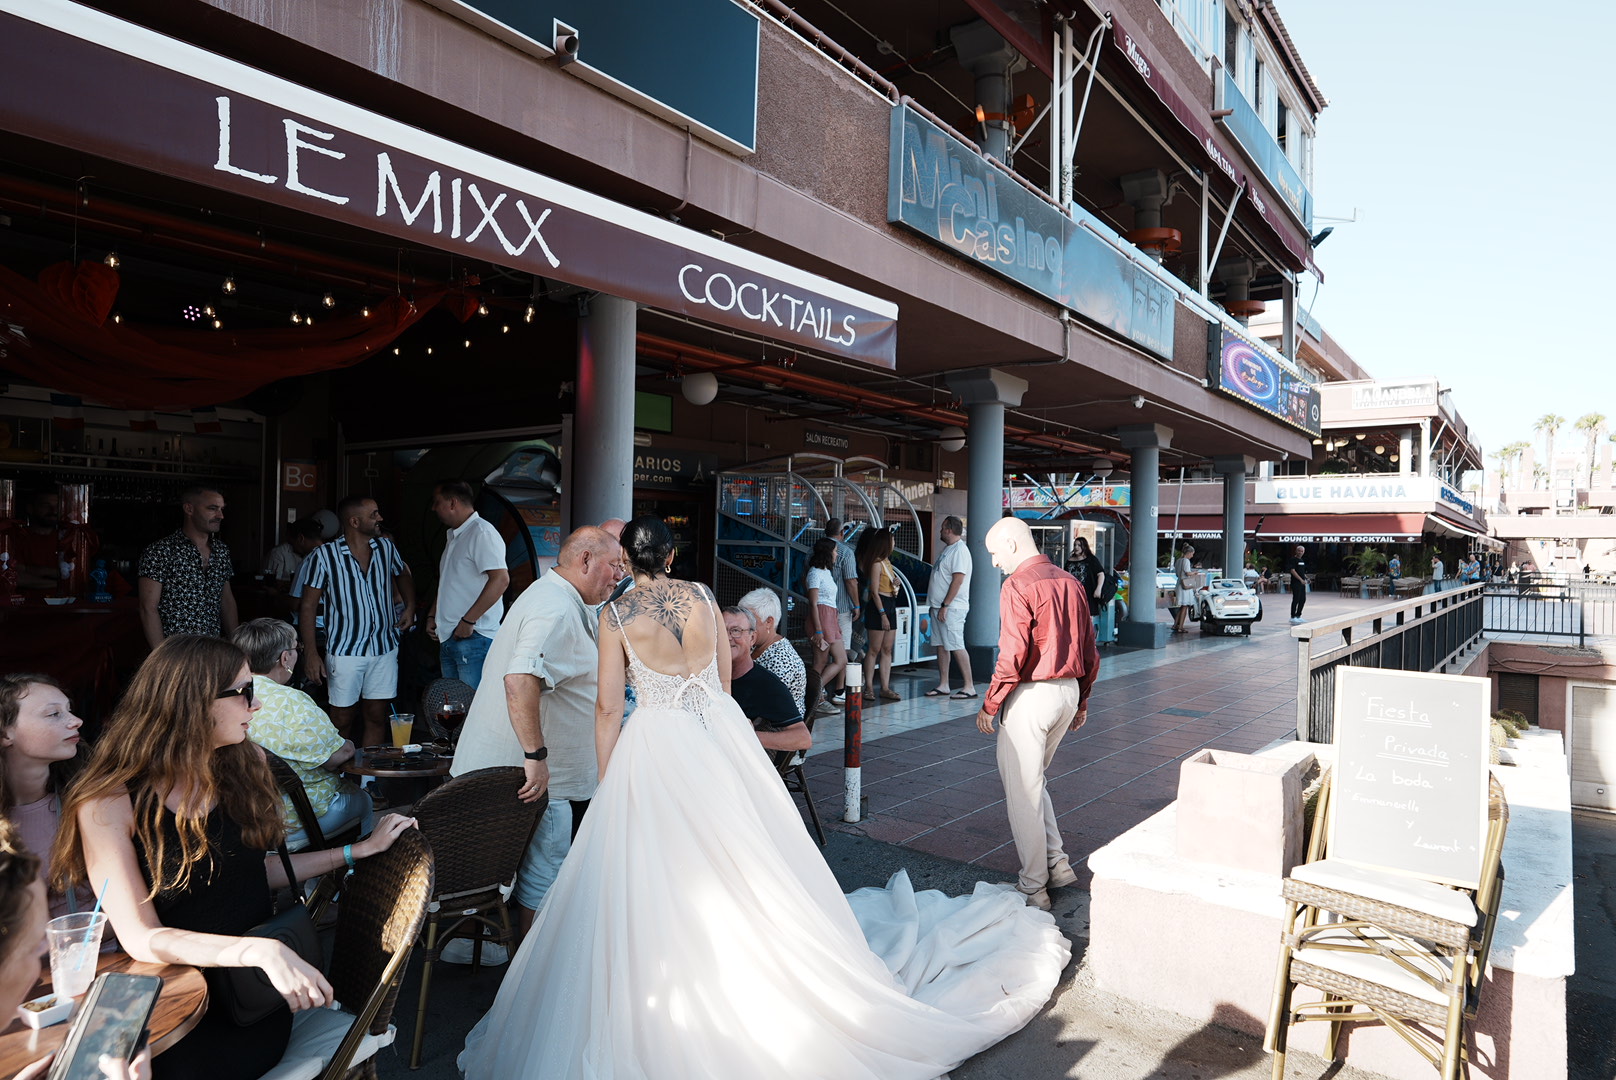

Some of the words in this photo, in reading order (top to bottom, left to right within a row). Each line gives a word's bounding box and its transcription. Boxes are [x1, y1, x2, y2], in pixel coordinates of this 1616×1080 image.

[214, 96, 350, 205] LE
[375, 151, 560, 268] MIXX
[902, 119, 998, 223] Mini
[938, 182, 1064, 272] Casino
[678, 264, 856, 347] COCKTAILS
[286, 465, 314, 488] Bc
[1276, 486, 1322, 499] BLUE
[1330, 484, 1407, 498] HAVANA
[1279, 535, 1314, 543] LOUNGE
[1322, 535, 1340, 543] BAR
[1349, 535, 1396, 543] COCKTAIL
[1366, 696, 1431, 723] Fiesta
[1385, 735, 1450, 760] Privada
[1355, 765, 1377, 782] La
[1392, 769, 1434, 789] boda
